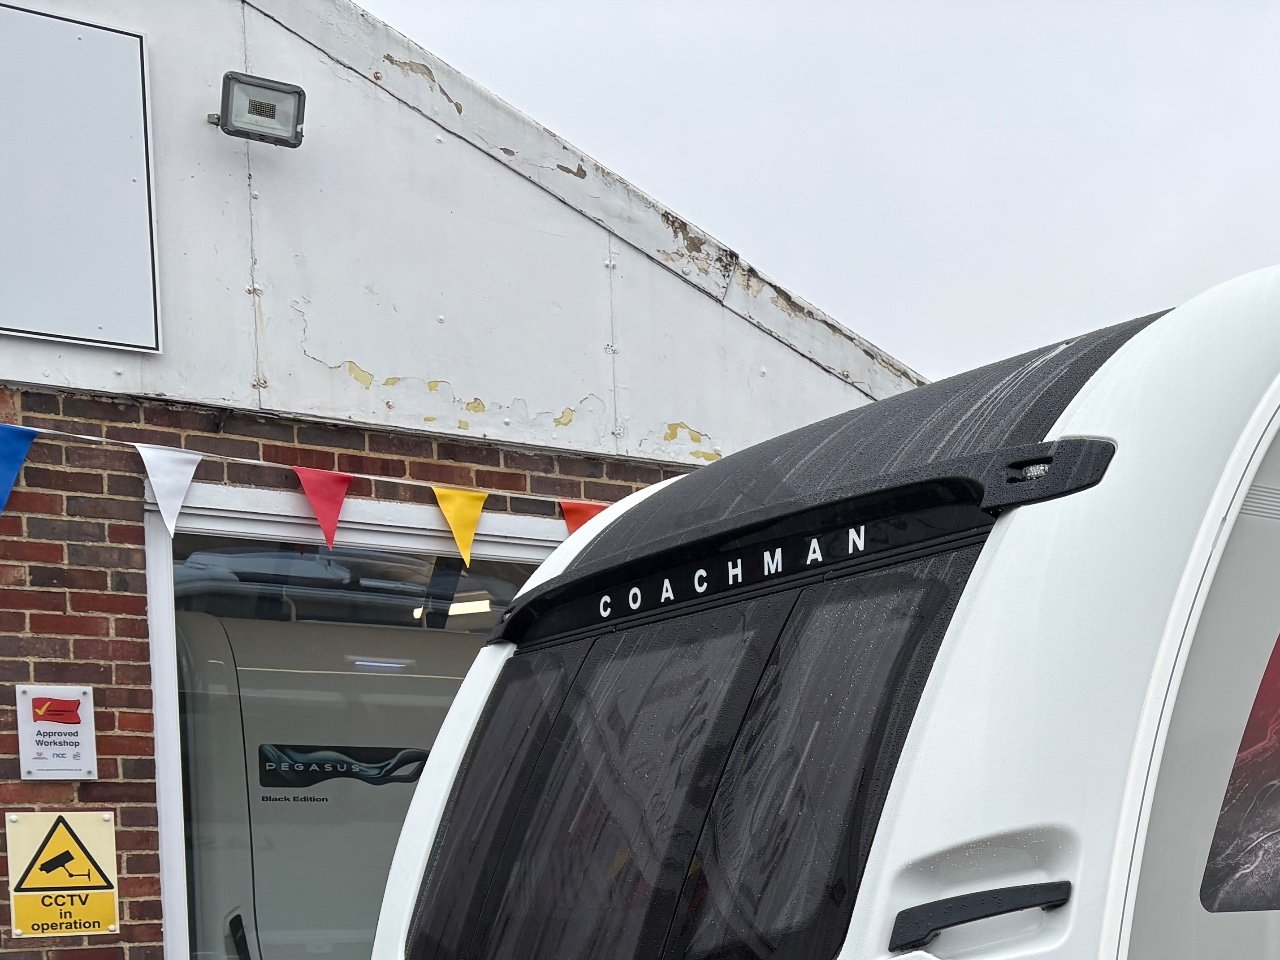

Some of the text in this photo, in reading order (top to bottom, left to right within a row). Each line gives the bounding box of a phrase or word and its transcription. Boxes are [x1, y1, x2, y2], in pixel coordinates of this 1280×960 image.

[600, 525, 866, 618] COACHMAN
[35, 729, 79, 738] Approved
[34, 739, 80, 748] Workshop
[265, 762, 361, 772] PEGASUS
[261, 795, 329, 803] Black Edition
[41, 893, 90, 907] CCTV
[59, 908, 73, 919] in
[31, 919, 101, 933] operation
